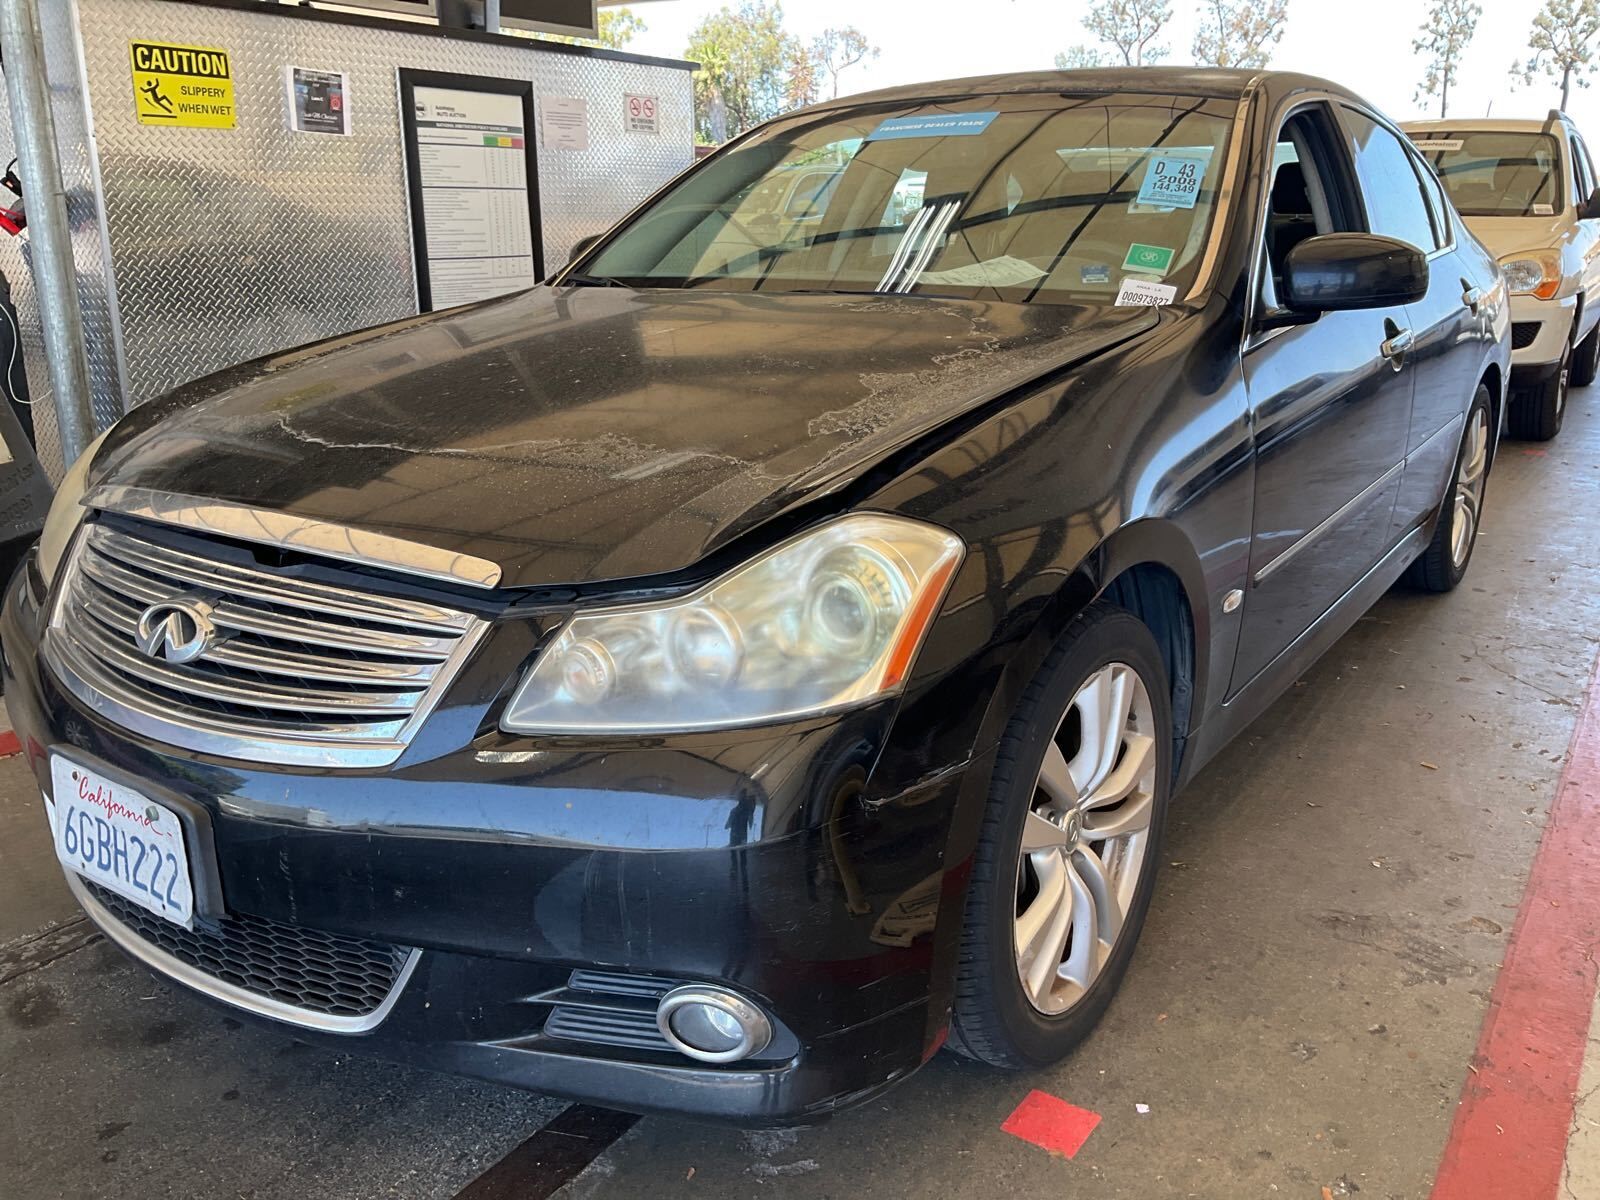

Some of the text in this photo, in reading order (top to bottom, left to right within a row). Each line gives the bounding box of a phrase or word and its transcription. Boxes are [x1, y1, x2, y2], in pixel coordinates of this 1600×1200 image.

[135, 46, 227, 76] CAUTION
[180, 85, 225, 98] SLIPPERY
[178, 103, 231, 116] WHEN WET
[879, 119, 985, 132] FRANCHISE DEALER TRADE
[1155, 161, 1196, 178] D 43
[1157, 175, 1197, 186] 2008
[1152, 182, 1195, 194] 144,349
[1121, 291, 1169, 306] 000973827
[79, 776, 164, 836] California
[65, 806, 182, 911] 6GBH222
